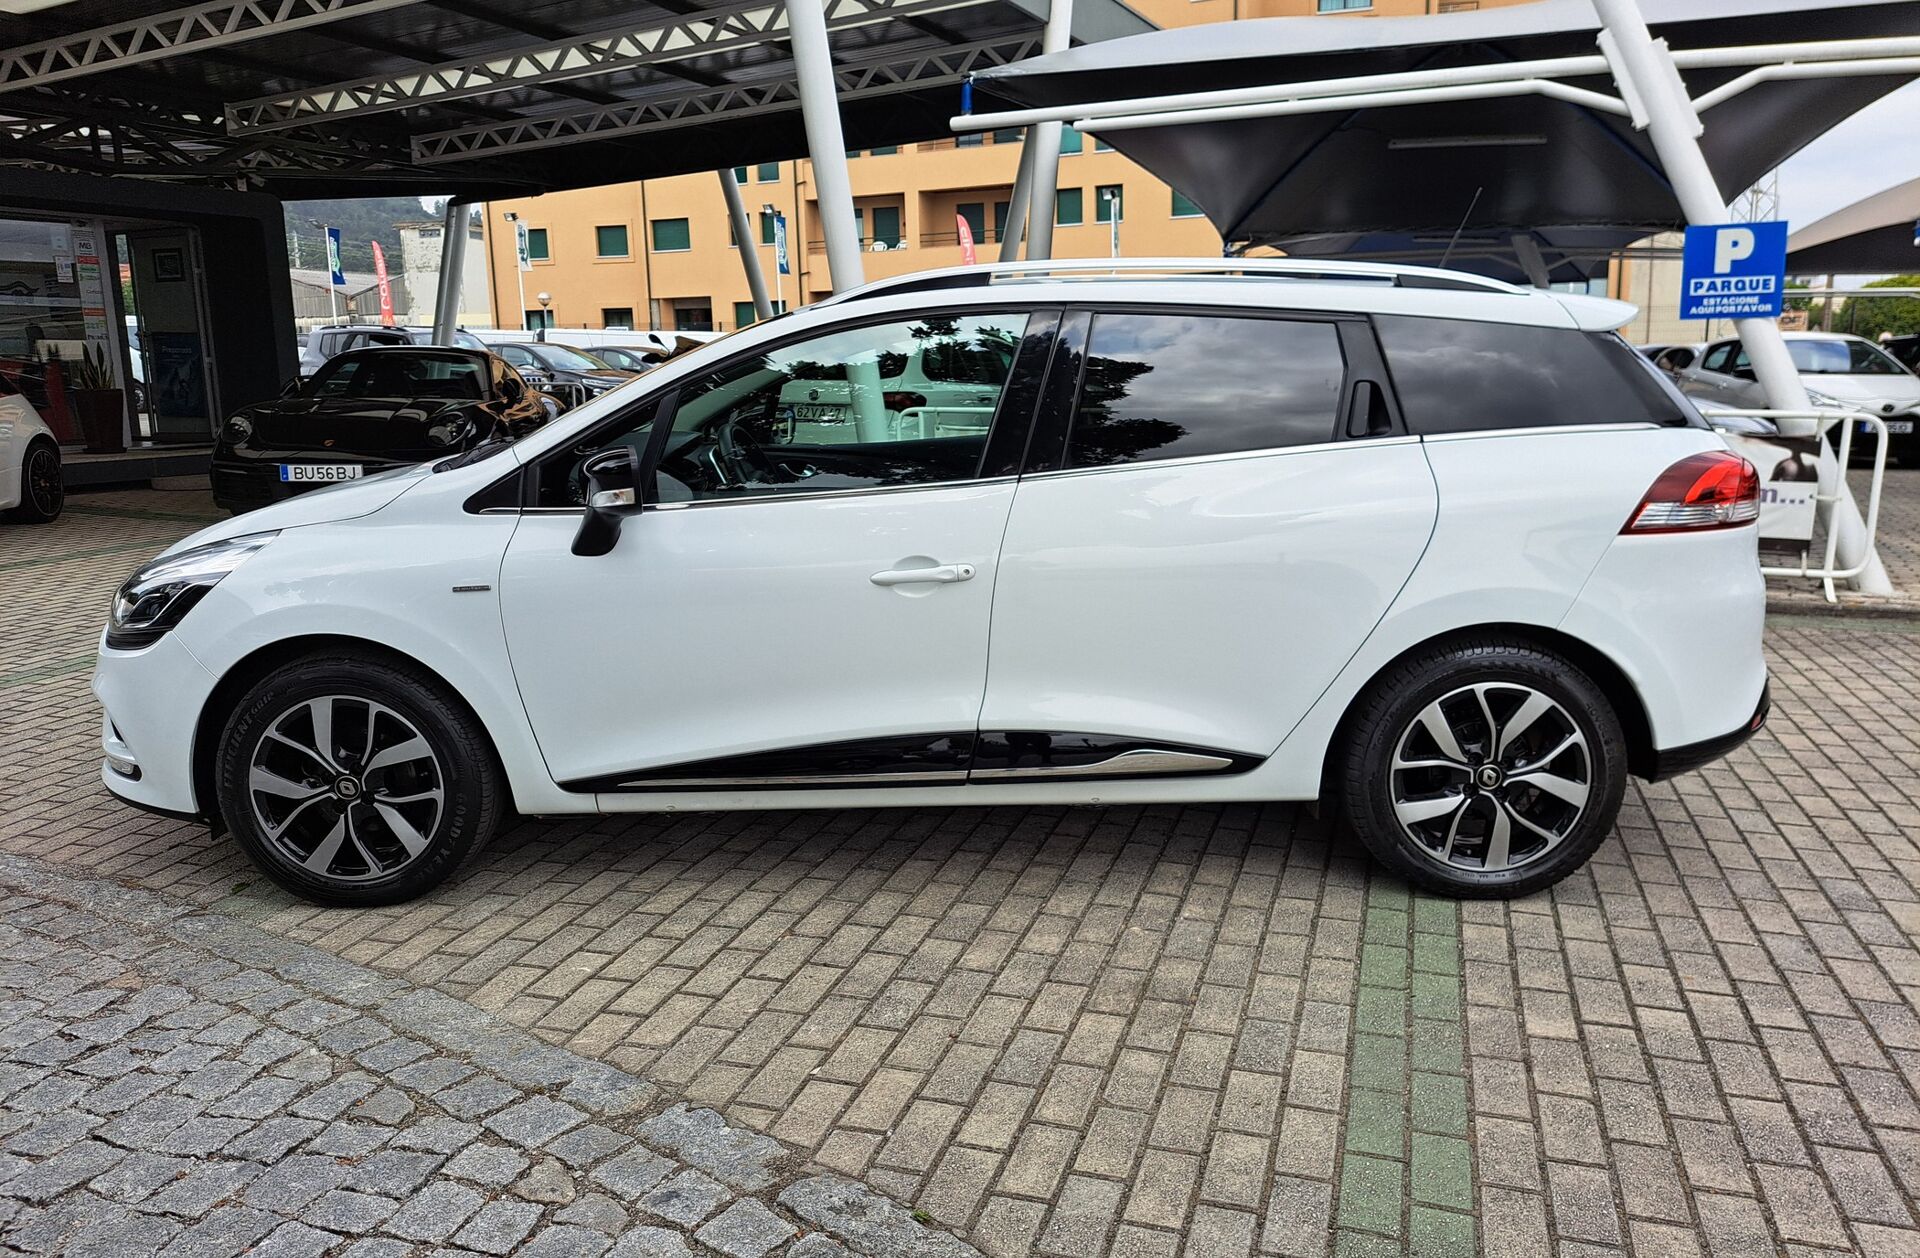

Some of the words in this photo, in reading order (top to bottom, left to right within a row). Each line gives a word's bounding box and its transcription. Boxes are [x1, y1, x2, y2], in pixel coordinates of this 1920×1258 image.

[1714, 228, 1755, 275] P
[1693, 278, 1772, 293] PARQUE
[1702, 296, 1759, 306] ESTACIONE
[1715, 305, 1736, 314] POR
[1737, 304, 1772, 313] FAVOR
[293, 466, 356, 480] BU56BJ
